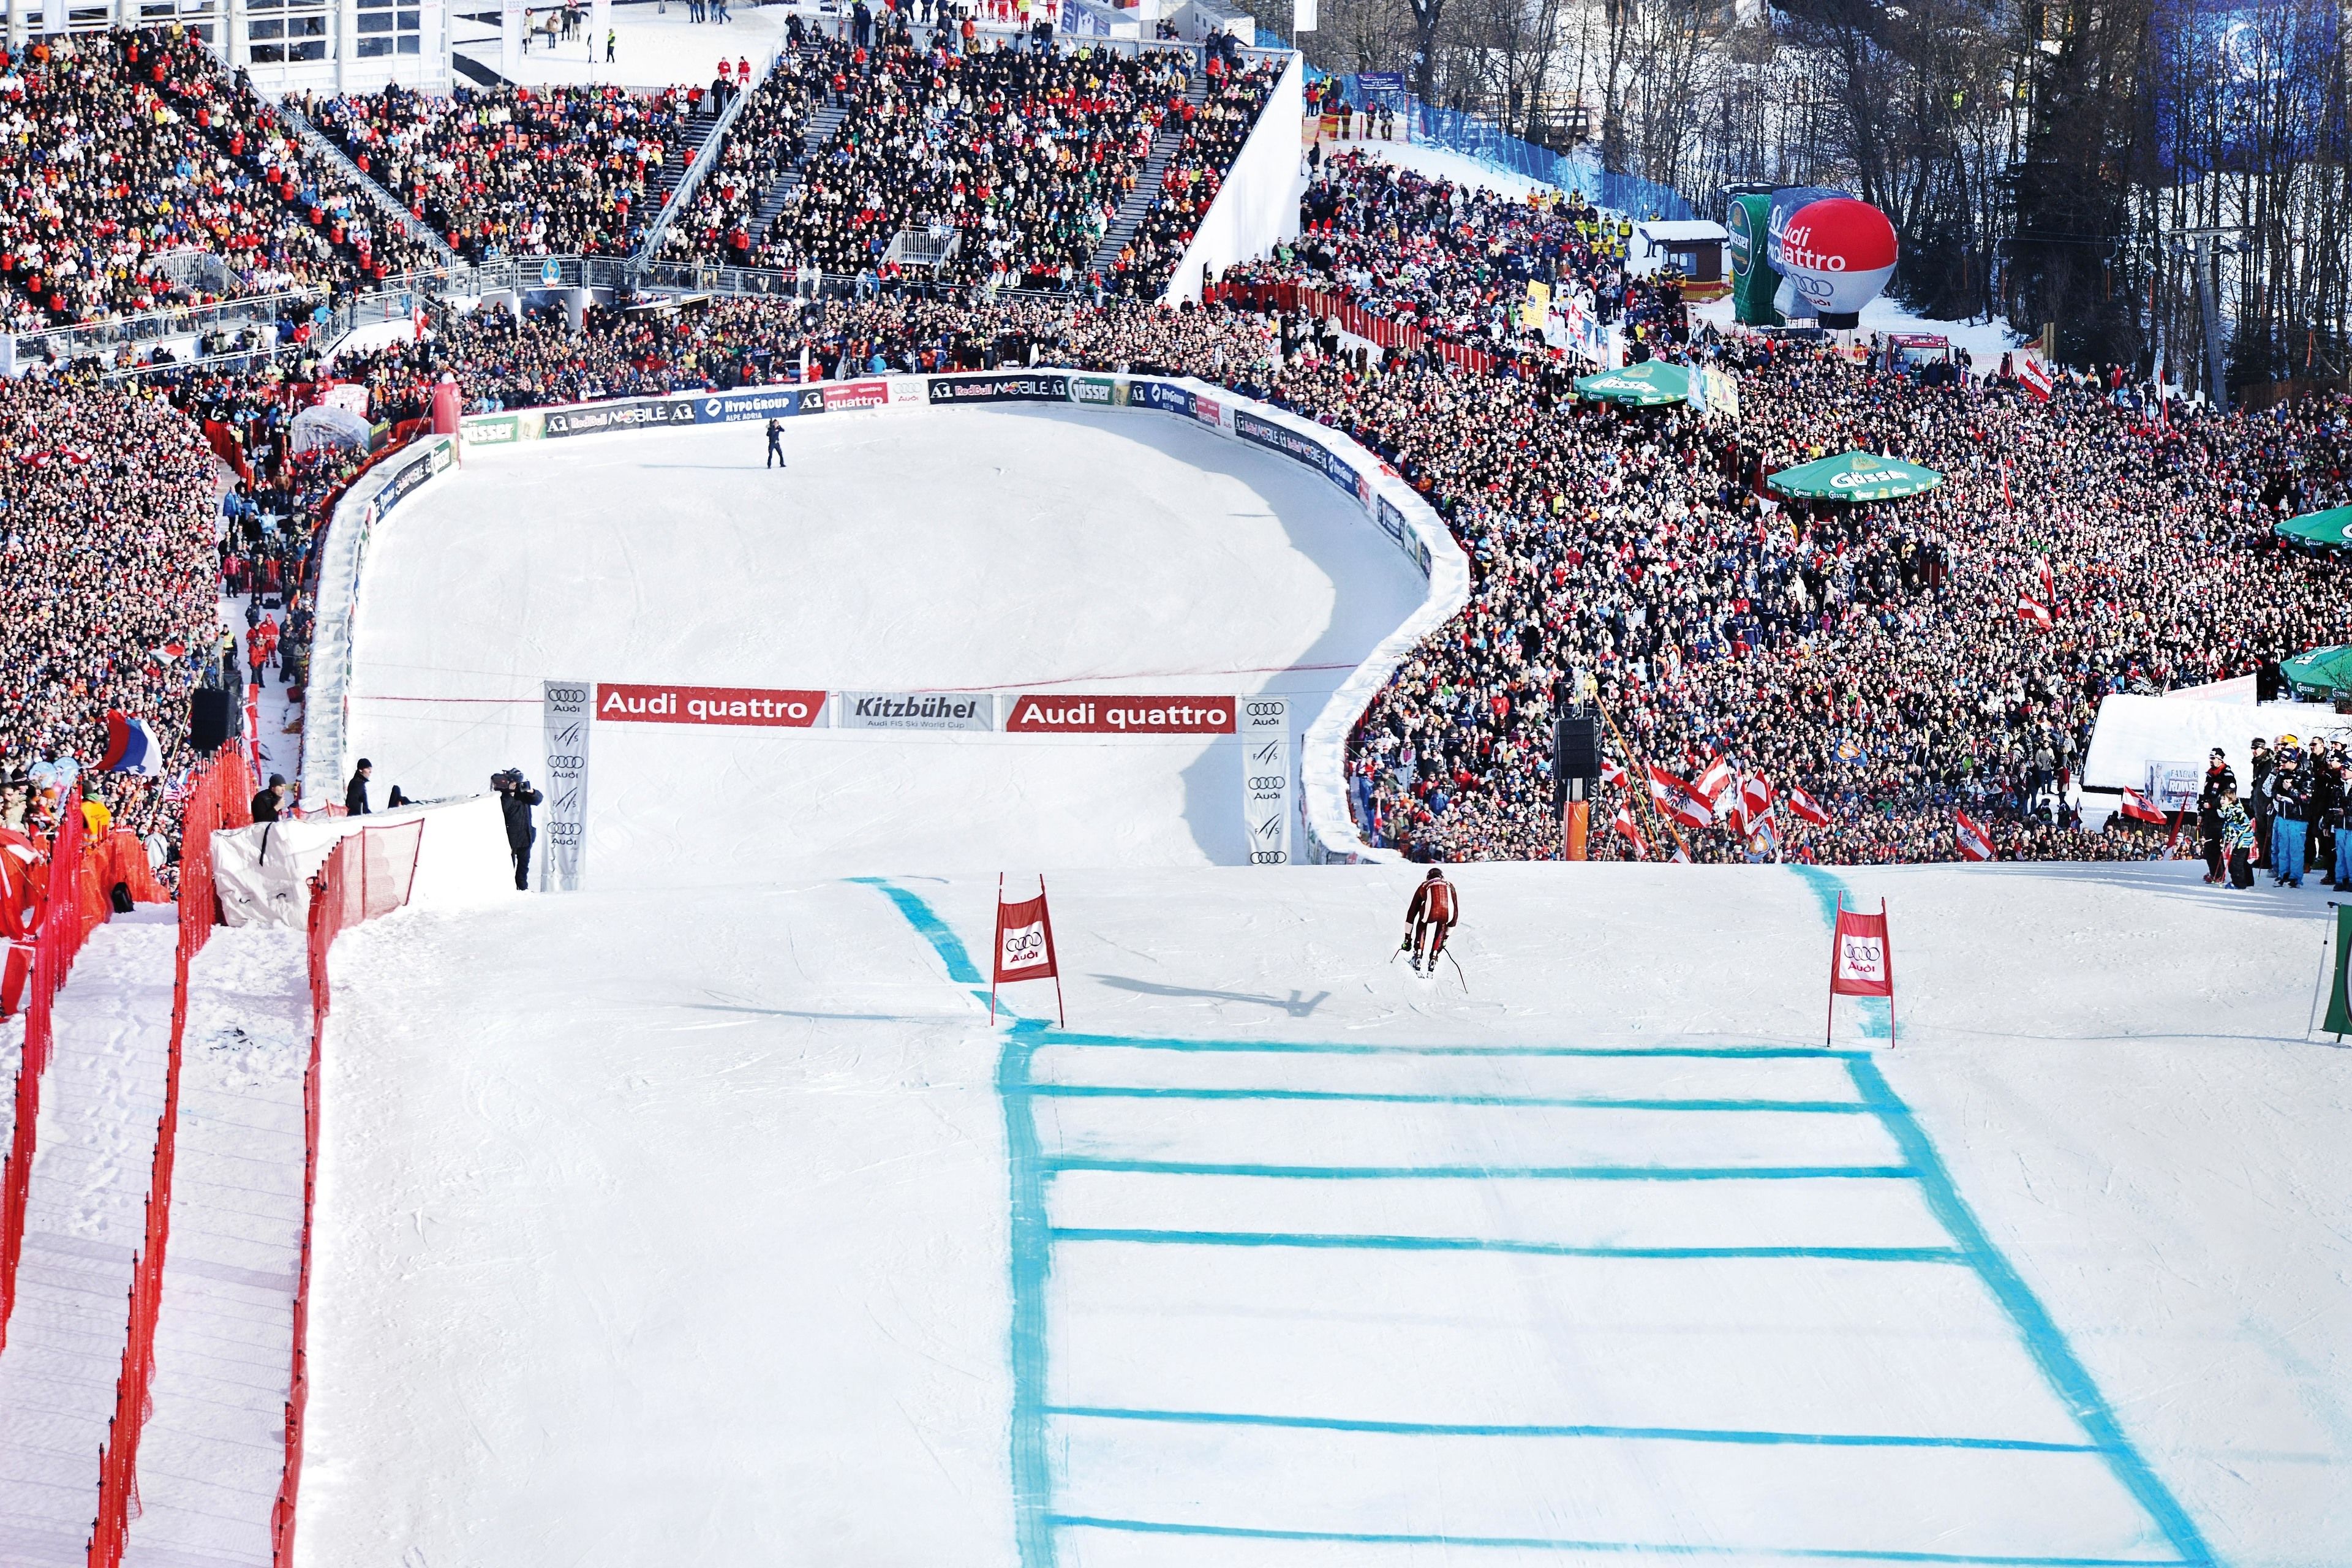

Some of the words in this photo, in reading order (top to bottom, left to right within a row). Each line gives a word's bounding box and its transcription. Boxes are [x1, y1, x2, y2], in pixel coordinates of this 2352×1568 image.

[1783, 224, 1811, 247] udi
[929, 382, 954, 398] A1
[993, 381, 1049, 396] MOBILE
[799, 392, 824, 410] A1
[827, 396, 883, 410] quattro
[608, 407, 668, 425] MOBILE
[671, 404, 695, 421] A1
[547, 415, 569, 432] A1
[602, 692, 677, 714] Audi
[687, 698, 808, 720] quattro
[855, 696, 977, 718] Kitzbühel
[1020, 703, 1095, 725] Audi
[1105, 705, 1227, 729] quattro
[1252, 717, 1280, 726] Audi
[1010, 950, 1038, 963] Audi
[1848, 961, 1875, 973] Audi
